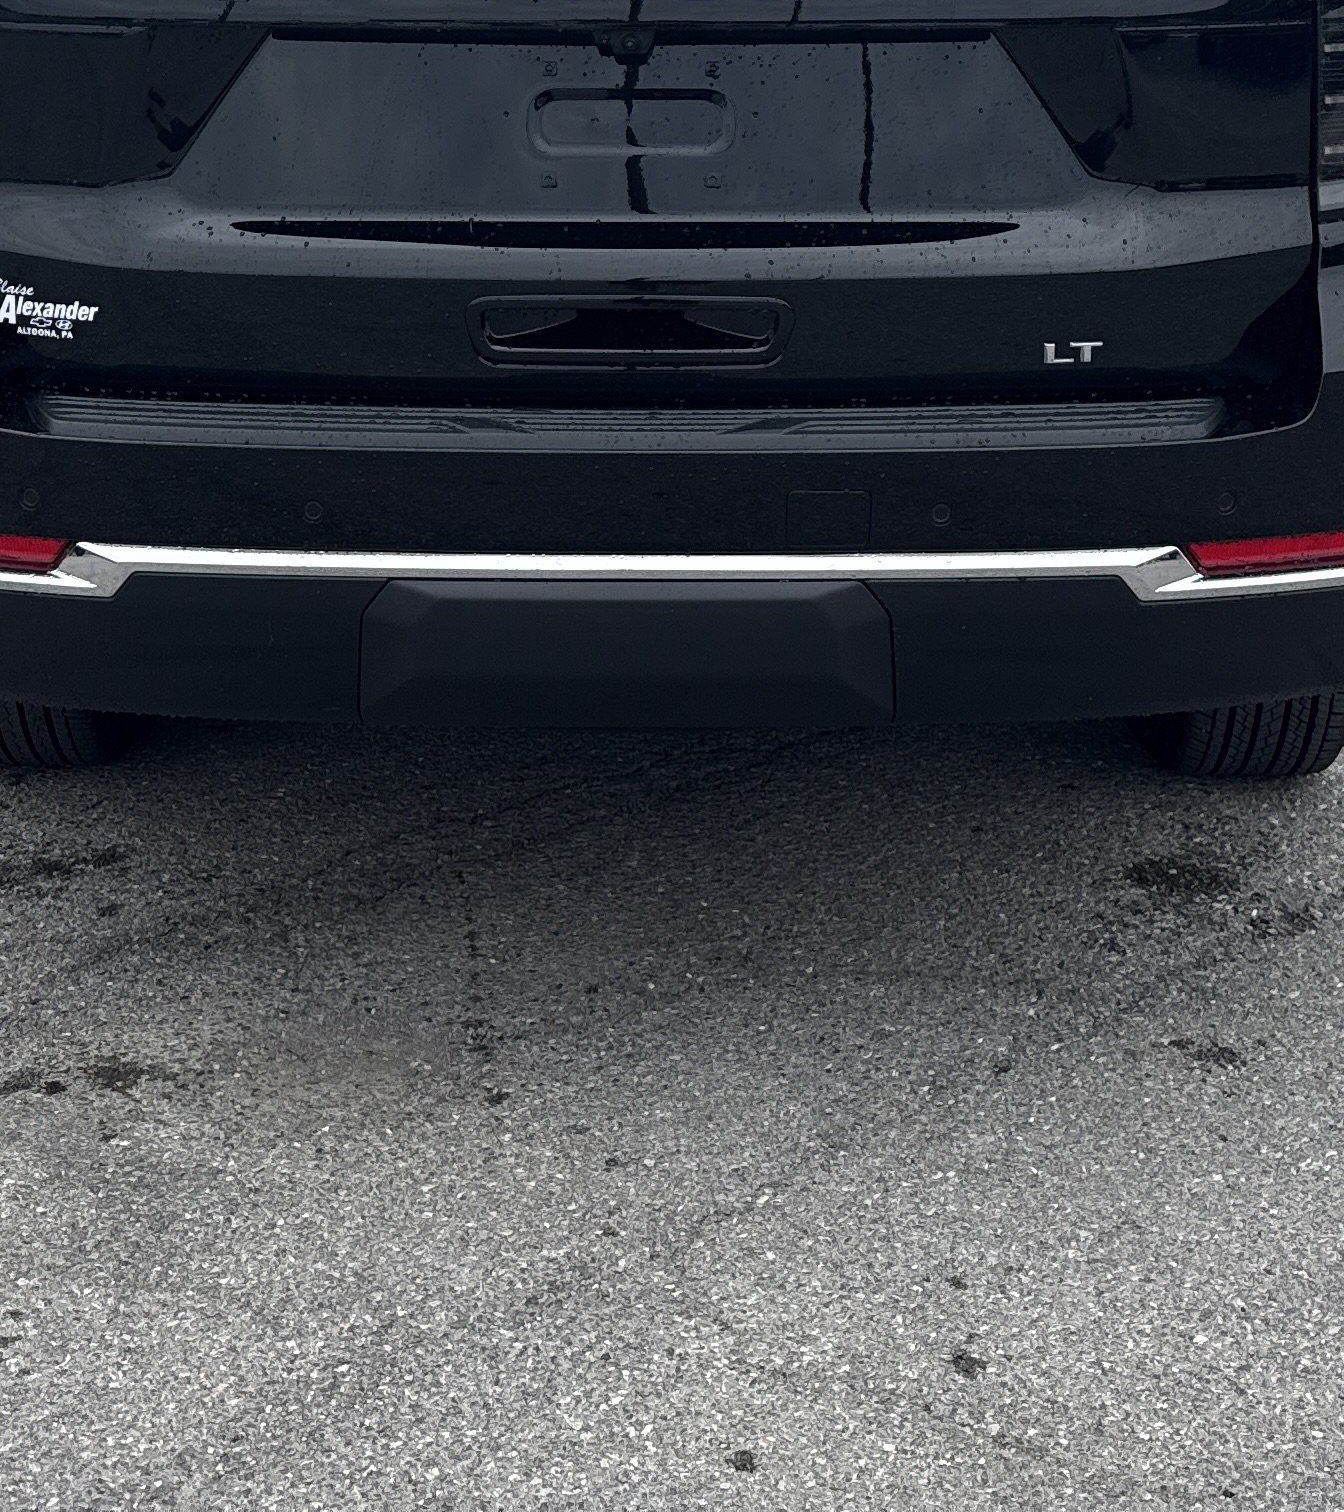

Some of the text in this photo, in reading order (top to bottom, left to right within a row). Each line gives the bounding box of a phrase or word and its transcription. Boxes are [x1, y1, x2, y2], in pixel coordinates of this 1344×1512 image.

[17, 326, 74, 339] ALTOONA, PA
[1043, 341, 1104, 364] LT
